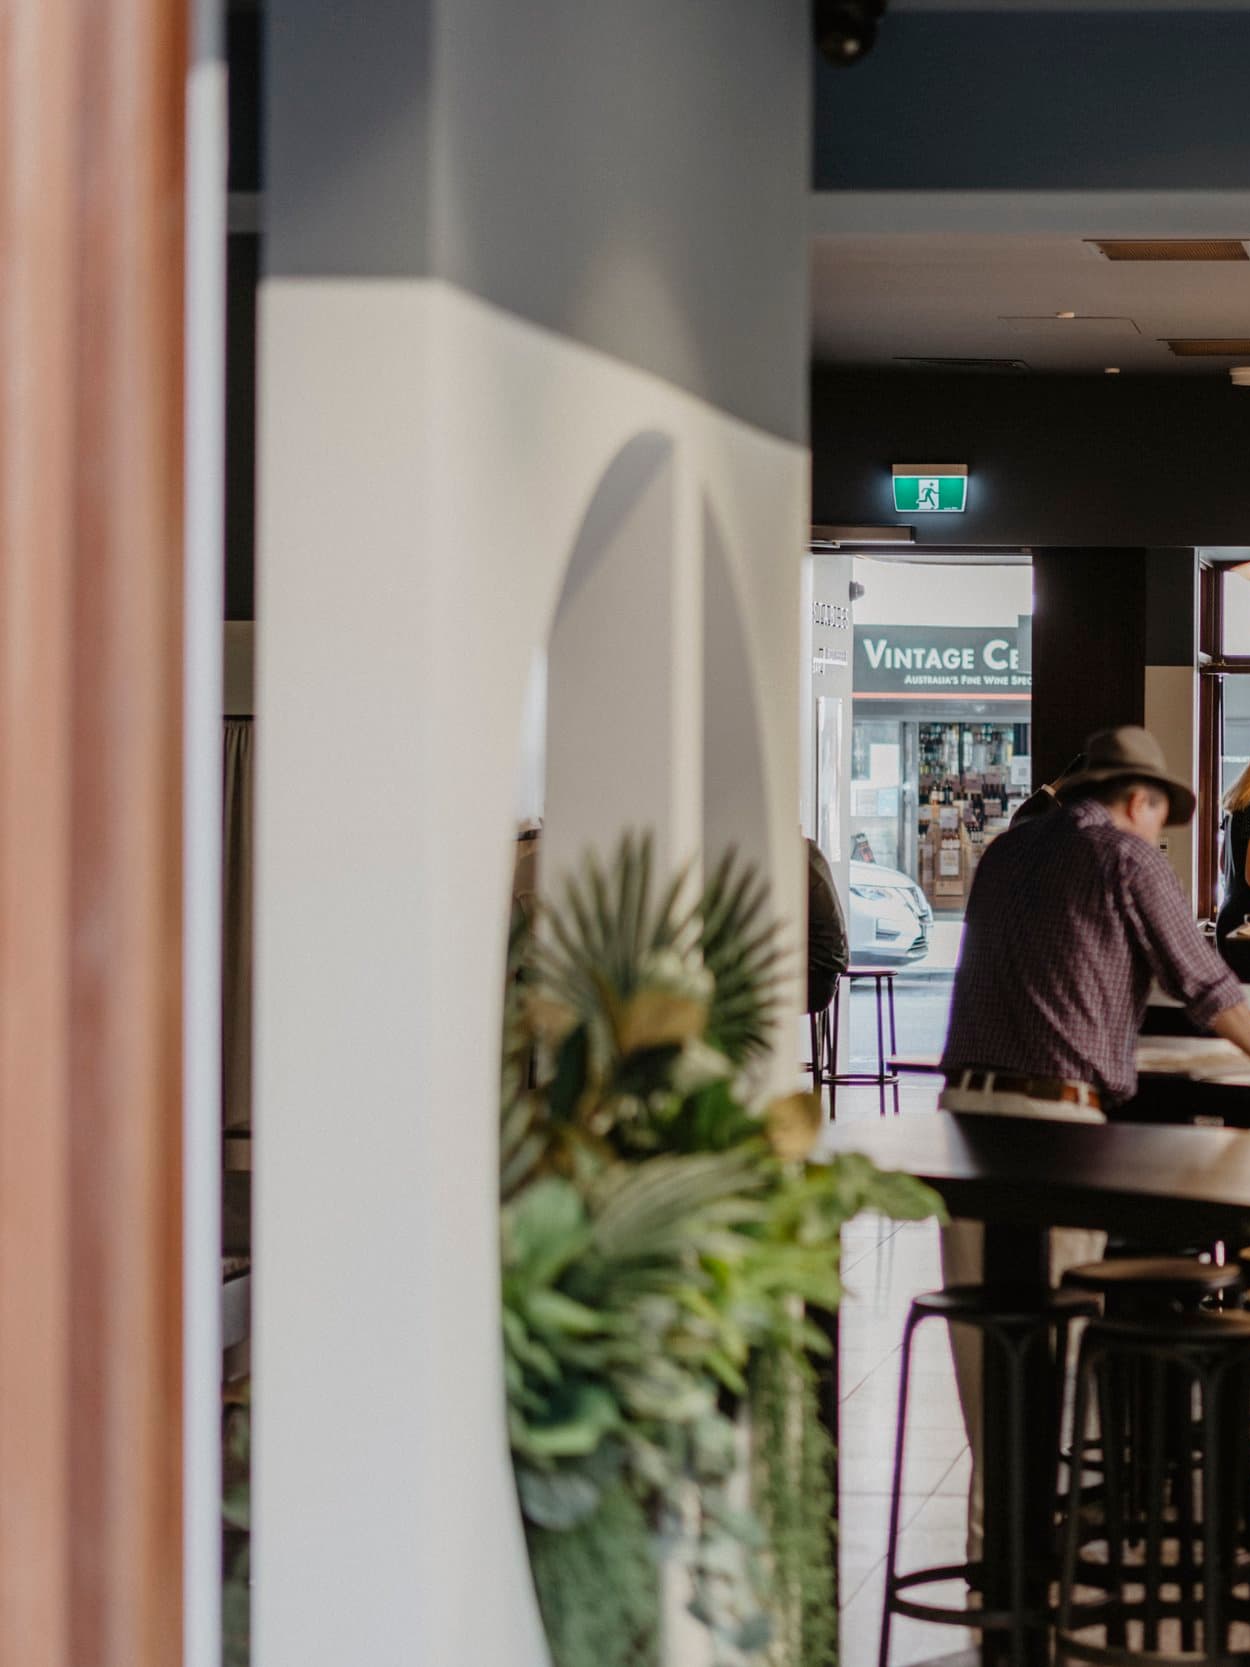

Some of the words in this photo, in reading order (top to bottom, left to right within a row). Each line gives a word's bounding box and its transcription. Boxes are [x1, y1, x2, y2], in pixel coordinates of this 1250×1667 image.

[863, 639, 974, 670] VINTAGE
[904, 675, 959, 686] AUSTRALIA'S
[961, 676, 982, 686] FINE
[984, 676, 1009, 686] WINE
